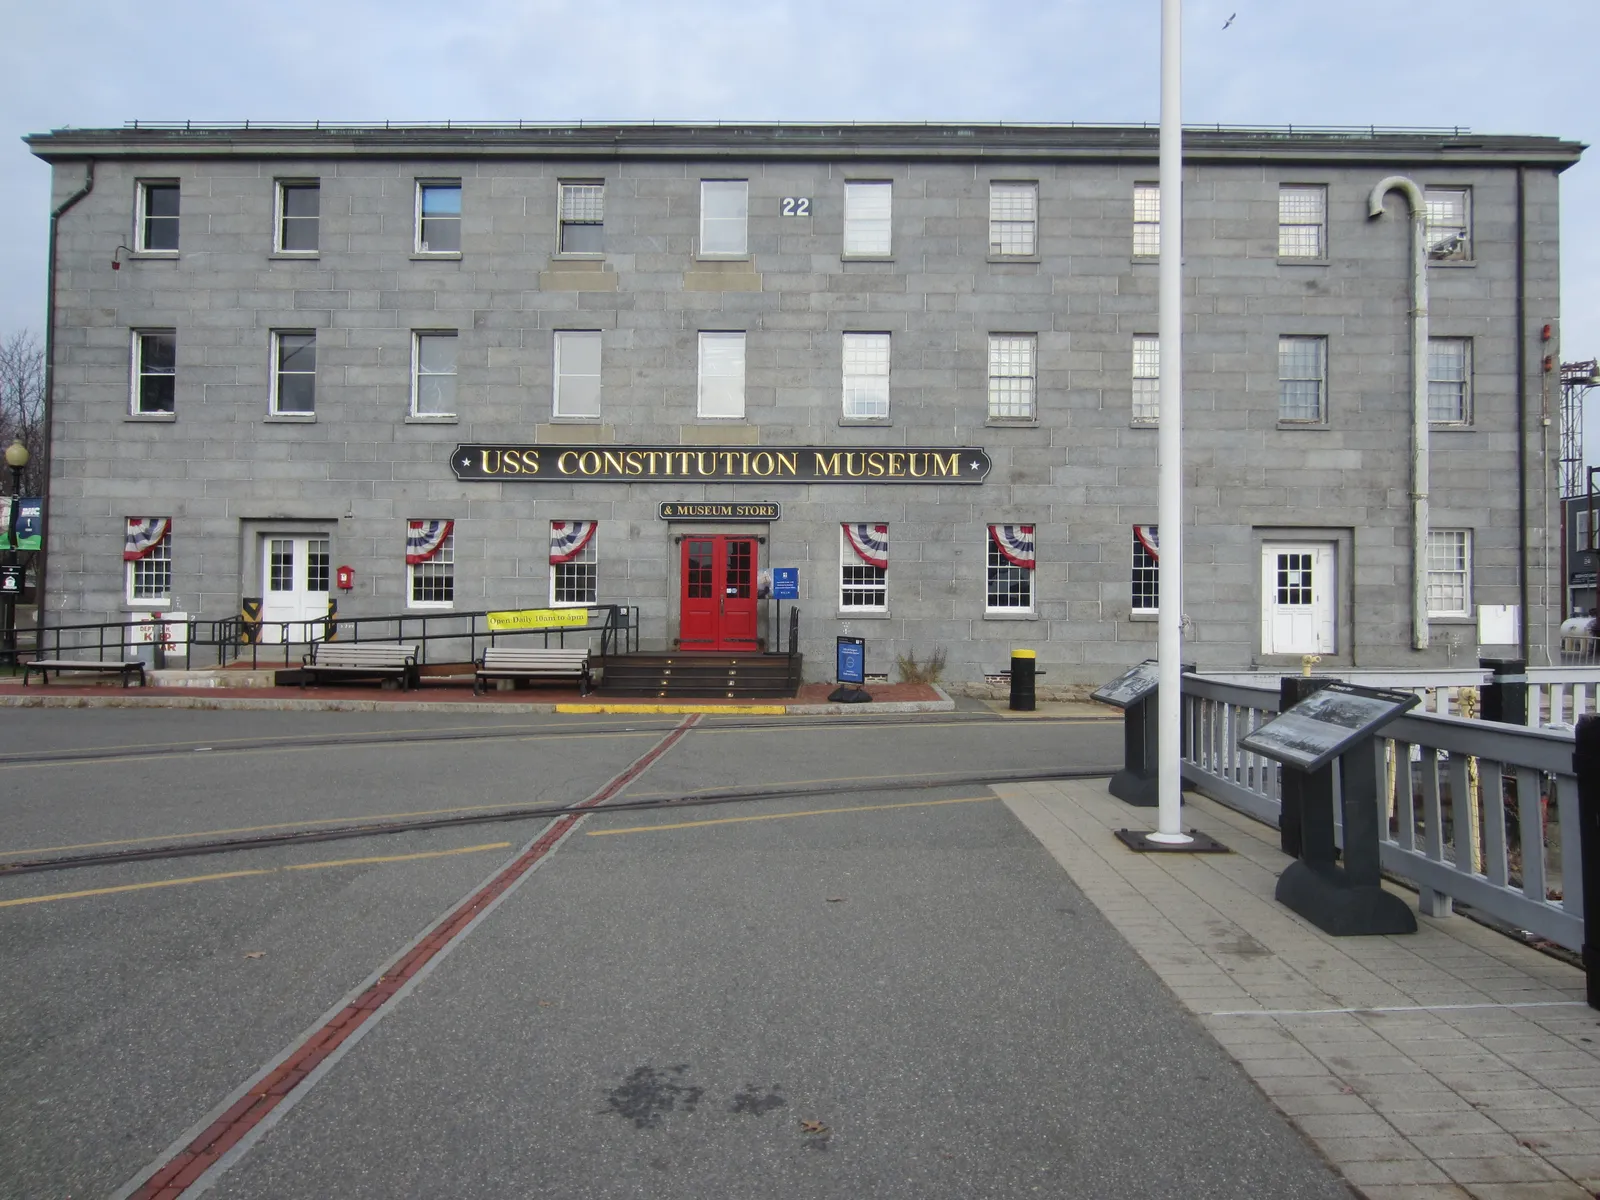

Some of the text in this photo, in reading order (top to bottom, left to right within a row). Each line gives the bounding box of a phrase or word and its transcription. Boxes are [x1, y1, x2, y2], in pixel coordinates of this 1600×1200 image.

[782, 197, 810, 217] 22
[481, 450, 962, 477] USS CONSTITUTION MUSEUM
[663, 505, 775, 516] & MUSEUM STORE
[490, 617, 511, 625] Open
[513, 616, 532, 624] Daily
[567, 613, 584, 621] 5pm
